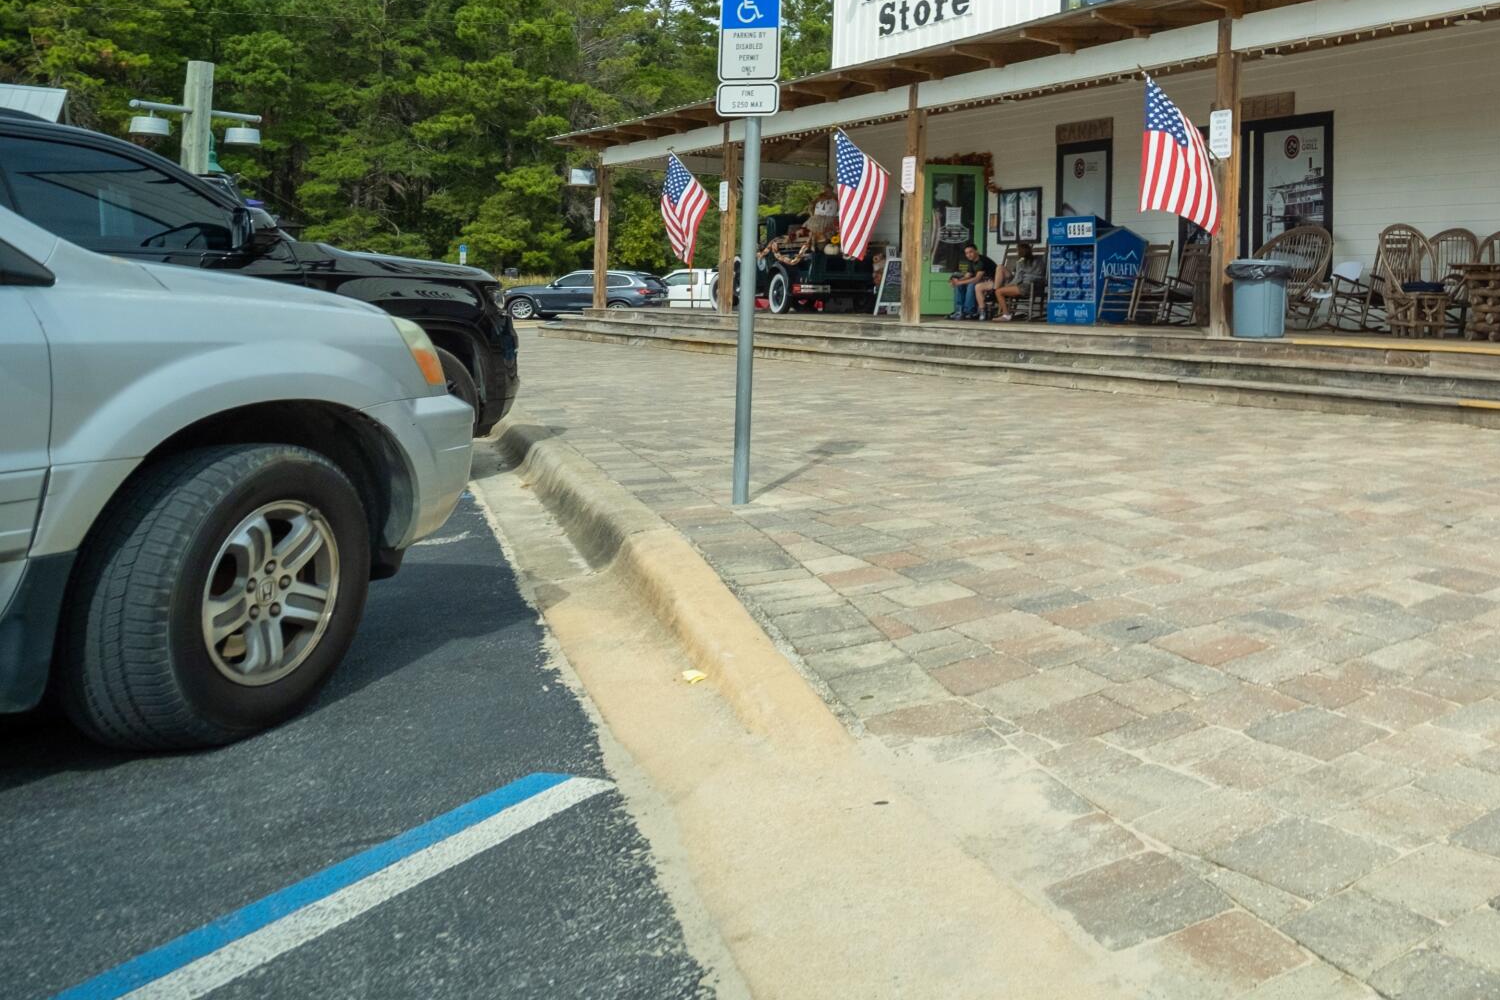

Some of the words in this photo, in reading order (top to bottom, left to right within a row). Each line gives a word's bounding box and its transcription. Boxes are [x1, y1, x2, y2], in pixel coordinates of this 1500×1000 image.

[758, 31, 766, 39] BY
[741, 65, 756, 73] ONLY
[731, 101, 749, 109] $250
[1099, 259, 1144, 280] AQUAFIN
